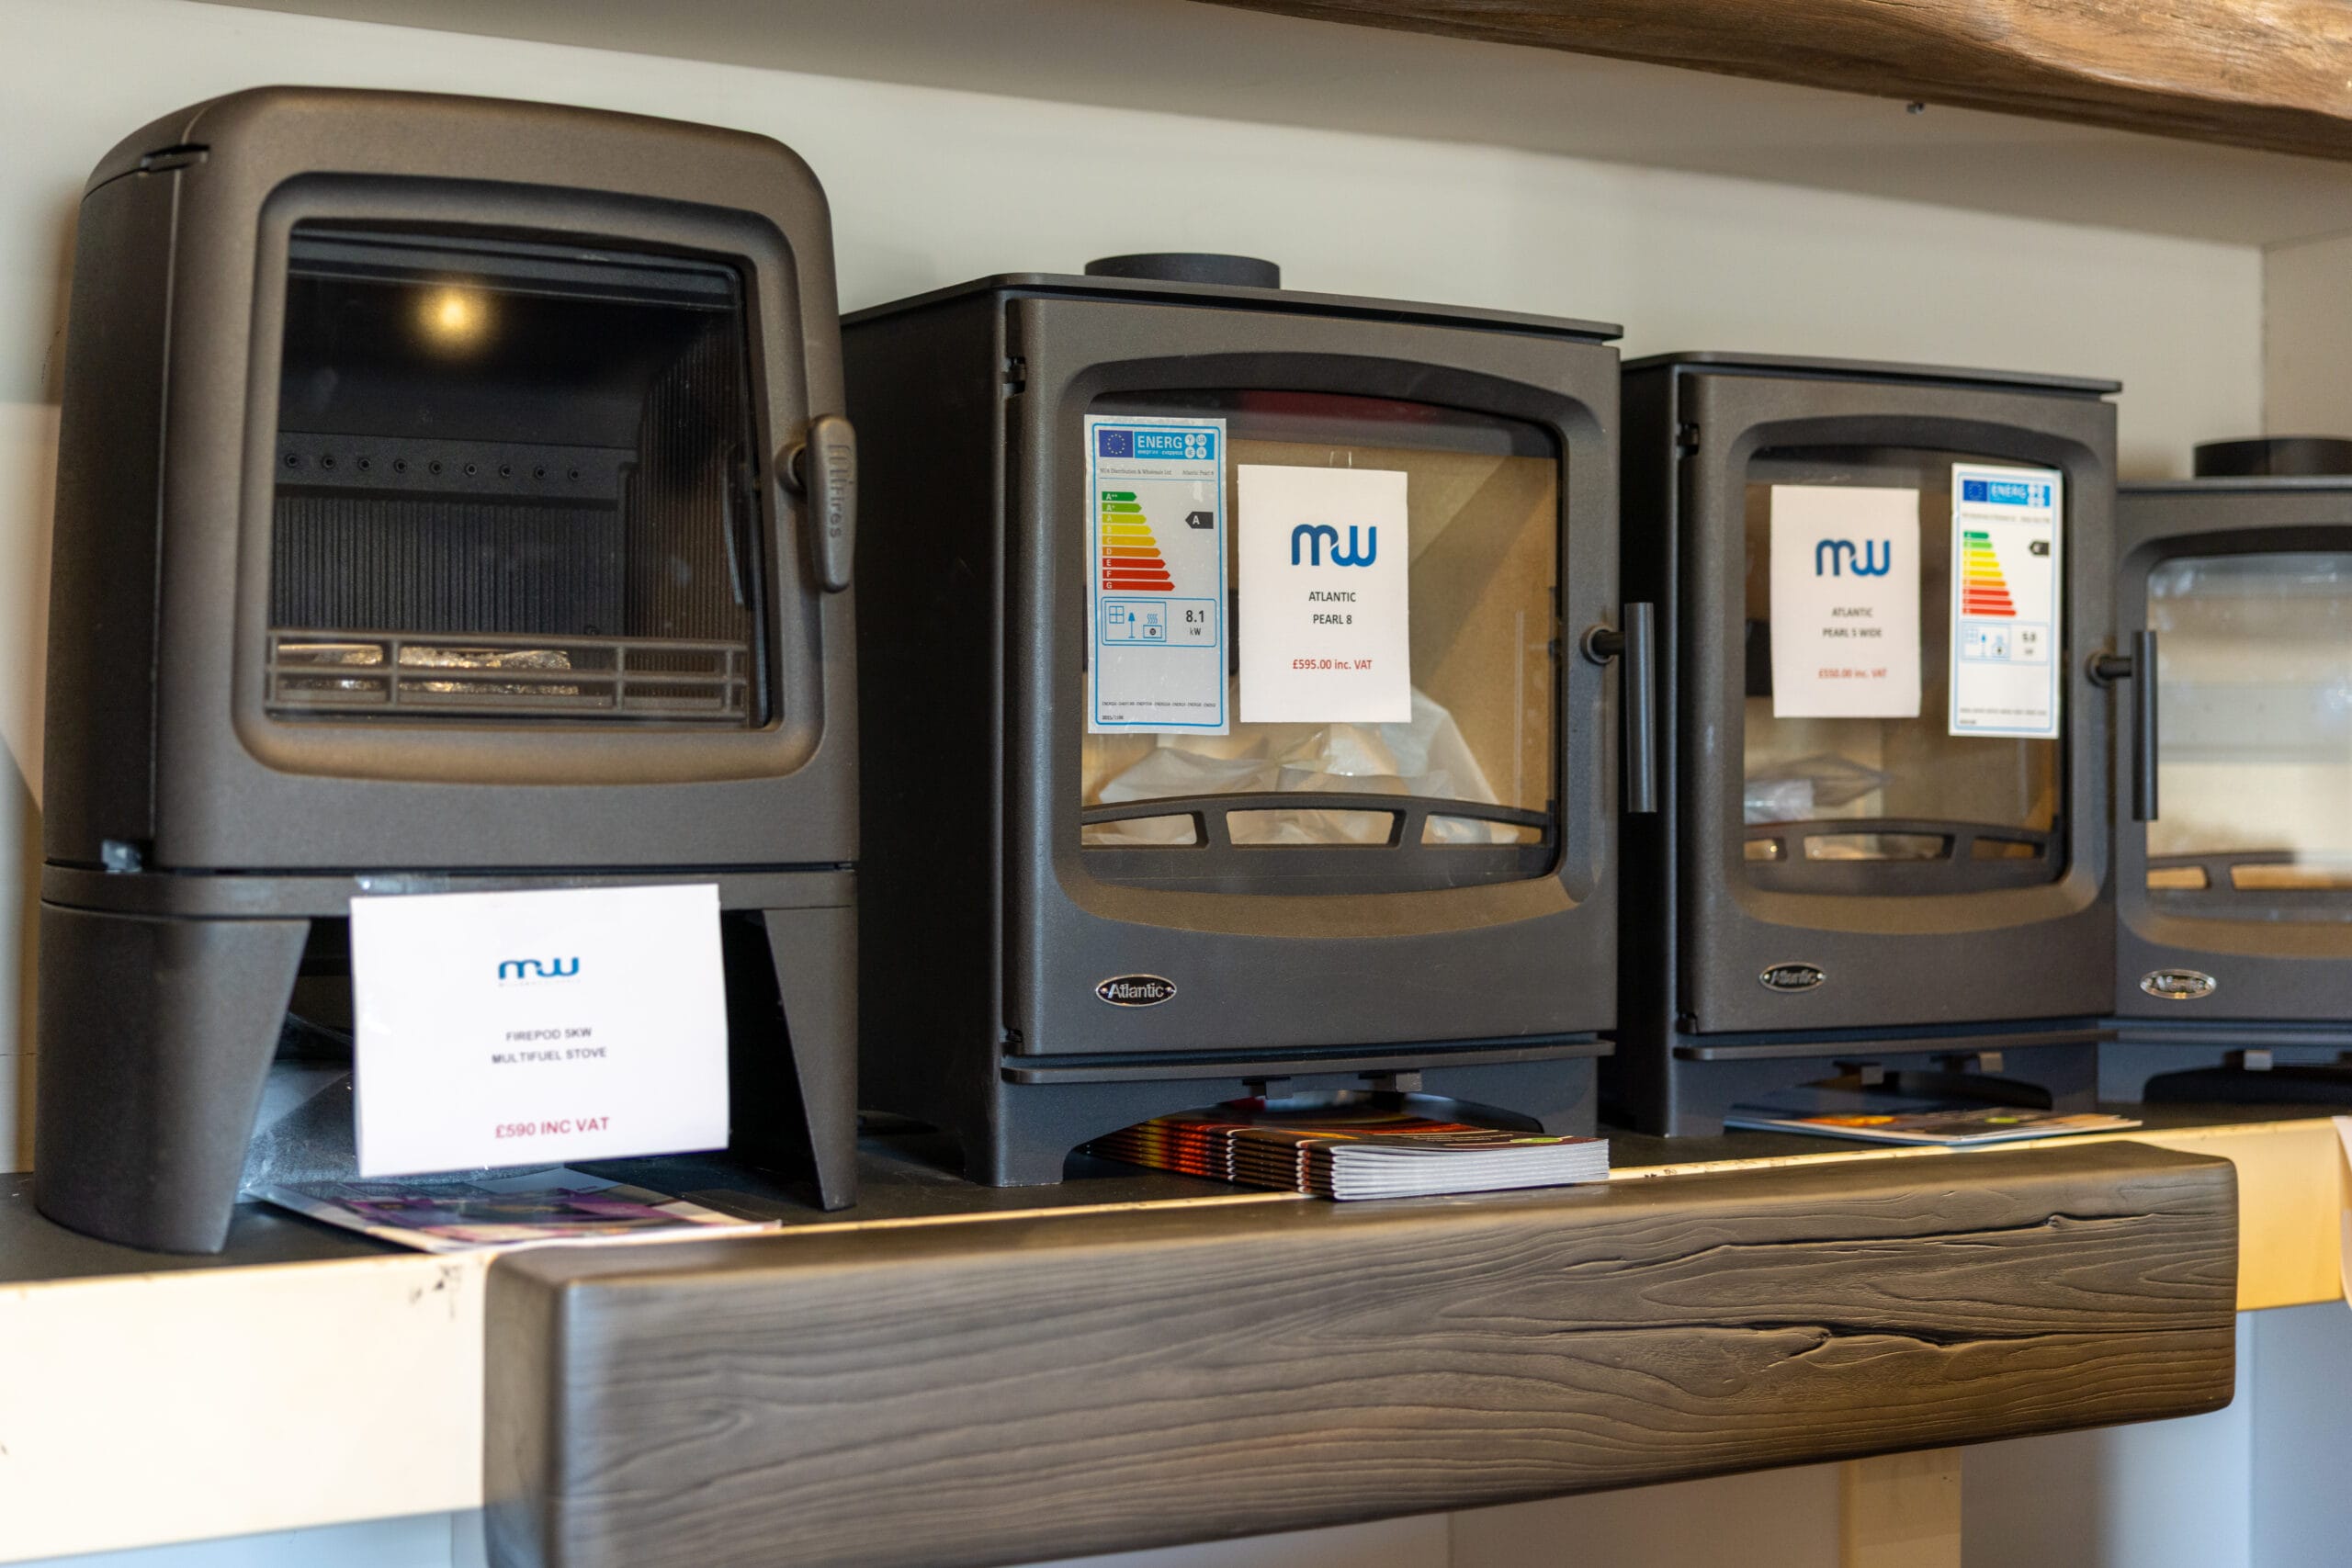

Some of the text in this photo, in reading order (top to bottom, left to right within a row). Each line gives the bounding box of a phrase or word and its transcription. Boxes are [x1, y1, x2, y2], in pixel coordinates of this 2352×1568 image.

[1136, 435, 1182, 449] ENERG
[1192, 515, 1200, 525] A
[1308, 592, 1356, 603] ATLANTIC
[1186, 610, 1204, 623] 8.1
[1831, 607, 1873, 618] ATLANTIC
[1313, 615, 1352, 625] PEARL 8
[1190, 627, 1202, 636] kW
[1822, 627, 1849, 638] PEARL
[1860, 627, 1883, 638] WIDE
[1293, 659, 1373, 670] £595.00 inc. VAT
[1871, 668, 1888, 678] VAT
[1107, 983, 1164, 998] Atlantic
[505, 1027, 593, 1041] FIREPOD 5KW
[492, 1046, 606, 1064] MULTIFUEL STOVE
[495, 1117, 609, 1139] £590 INC VAT
